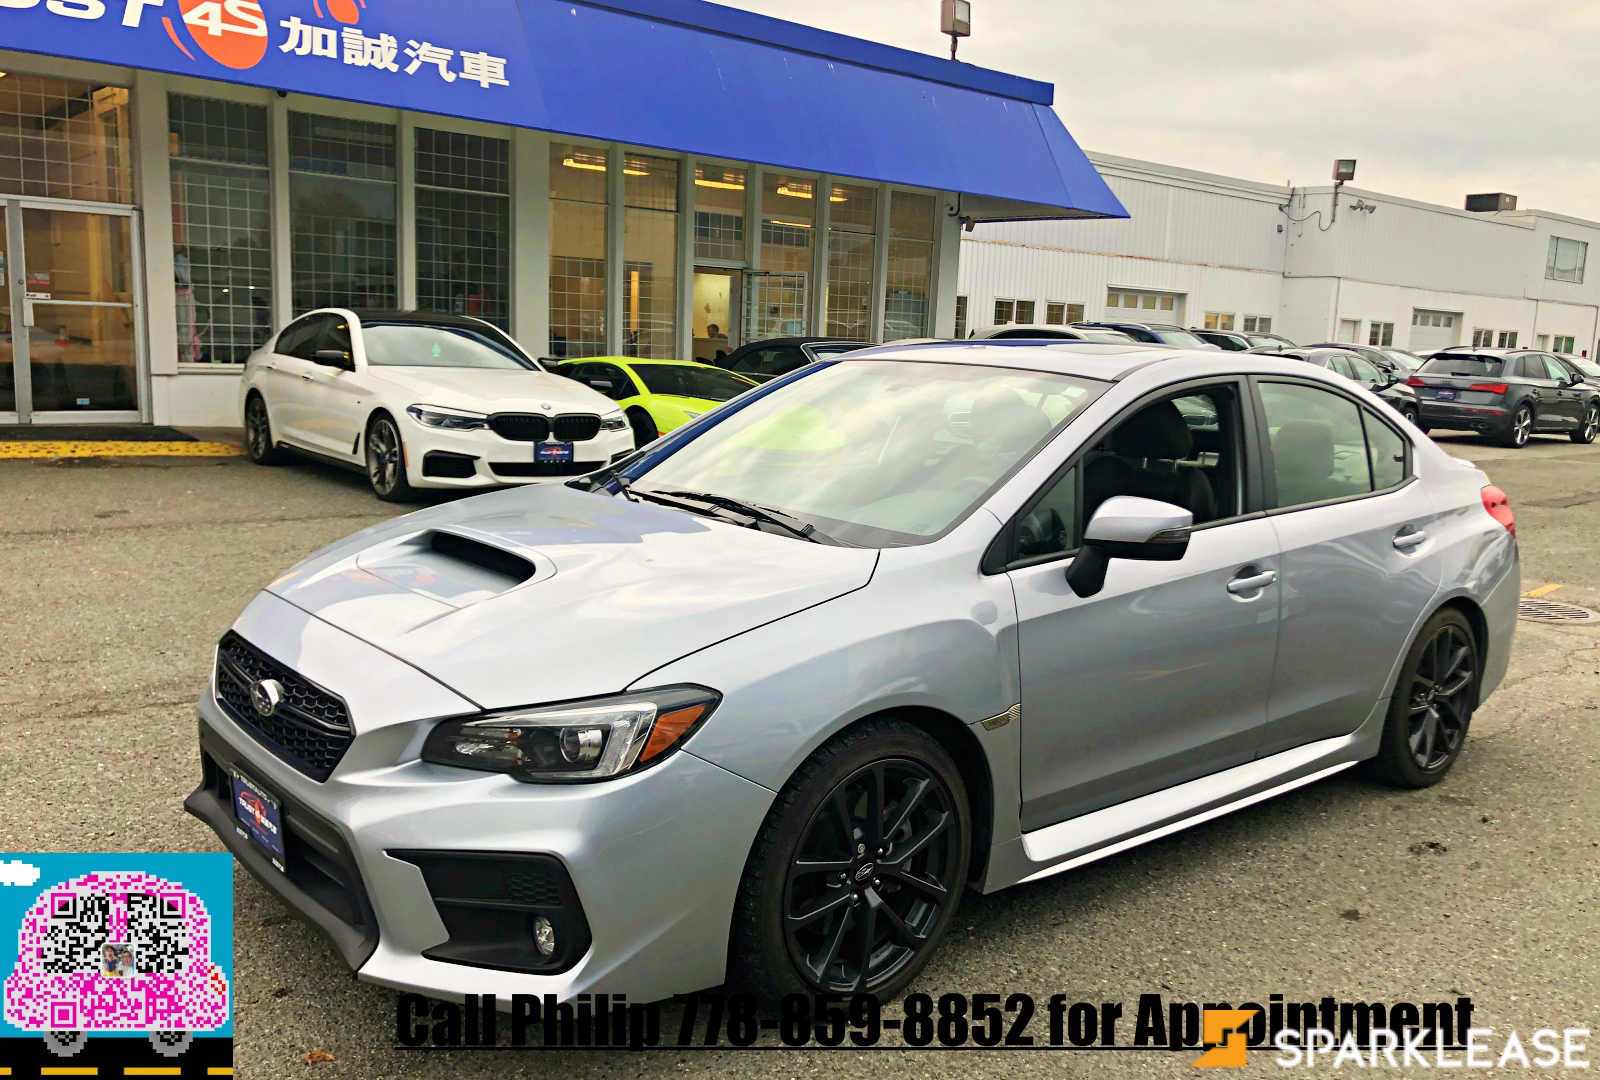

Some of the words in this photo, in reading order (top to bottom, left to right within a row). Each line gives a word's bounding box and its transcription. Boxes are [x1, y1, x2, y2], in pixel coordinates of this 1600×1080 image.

[182, 0, 268, 38] 4S
[279, 15, 510, 89] 加誠汽車
